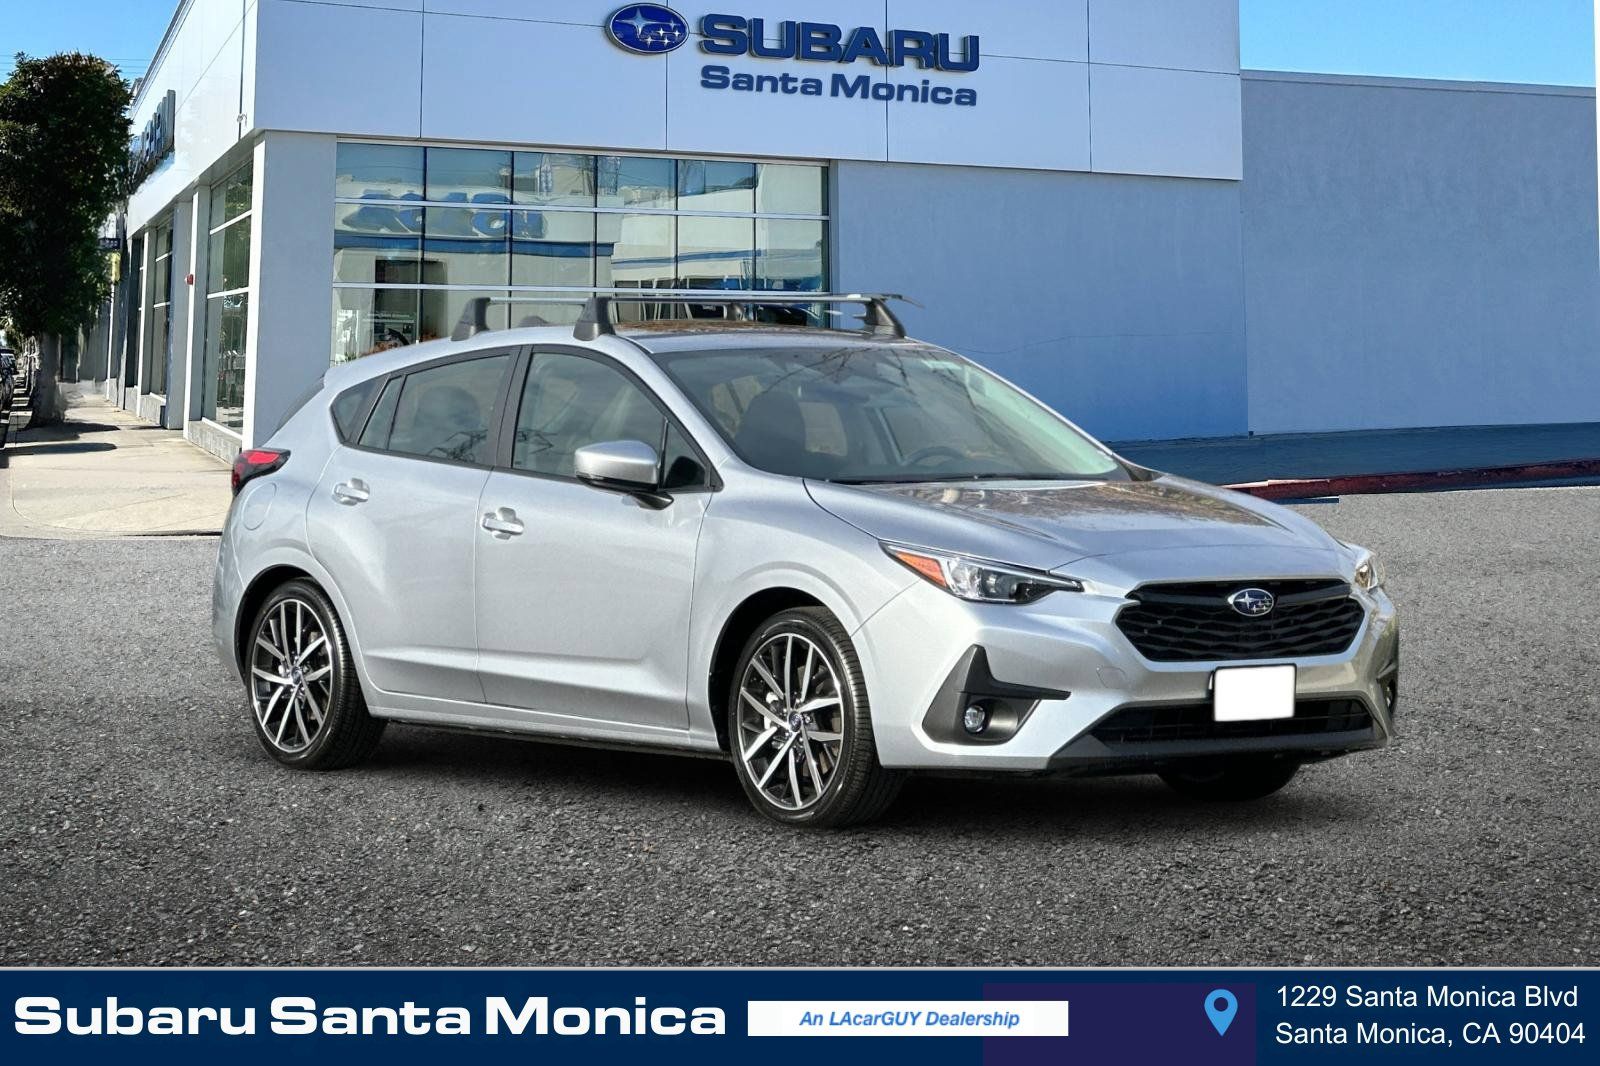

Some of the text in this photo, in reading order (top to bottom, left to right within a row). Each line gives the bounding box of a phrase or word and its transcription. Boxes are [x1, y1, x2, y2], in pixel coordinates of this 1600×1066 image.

[700, 13, 979, 72] SUBARU
[701, 65, 977, 106] Santa Monica
